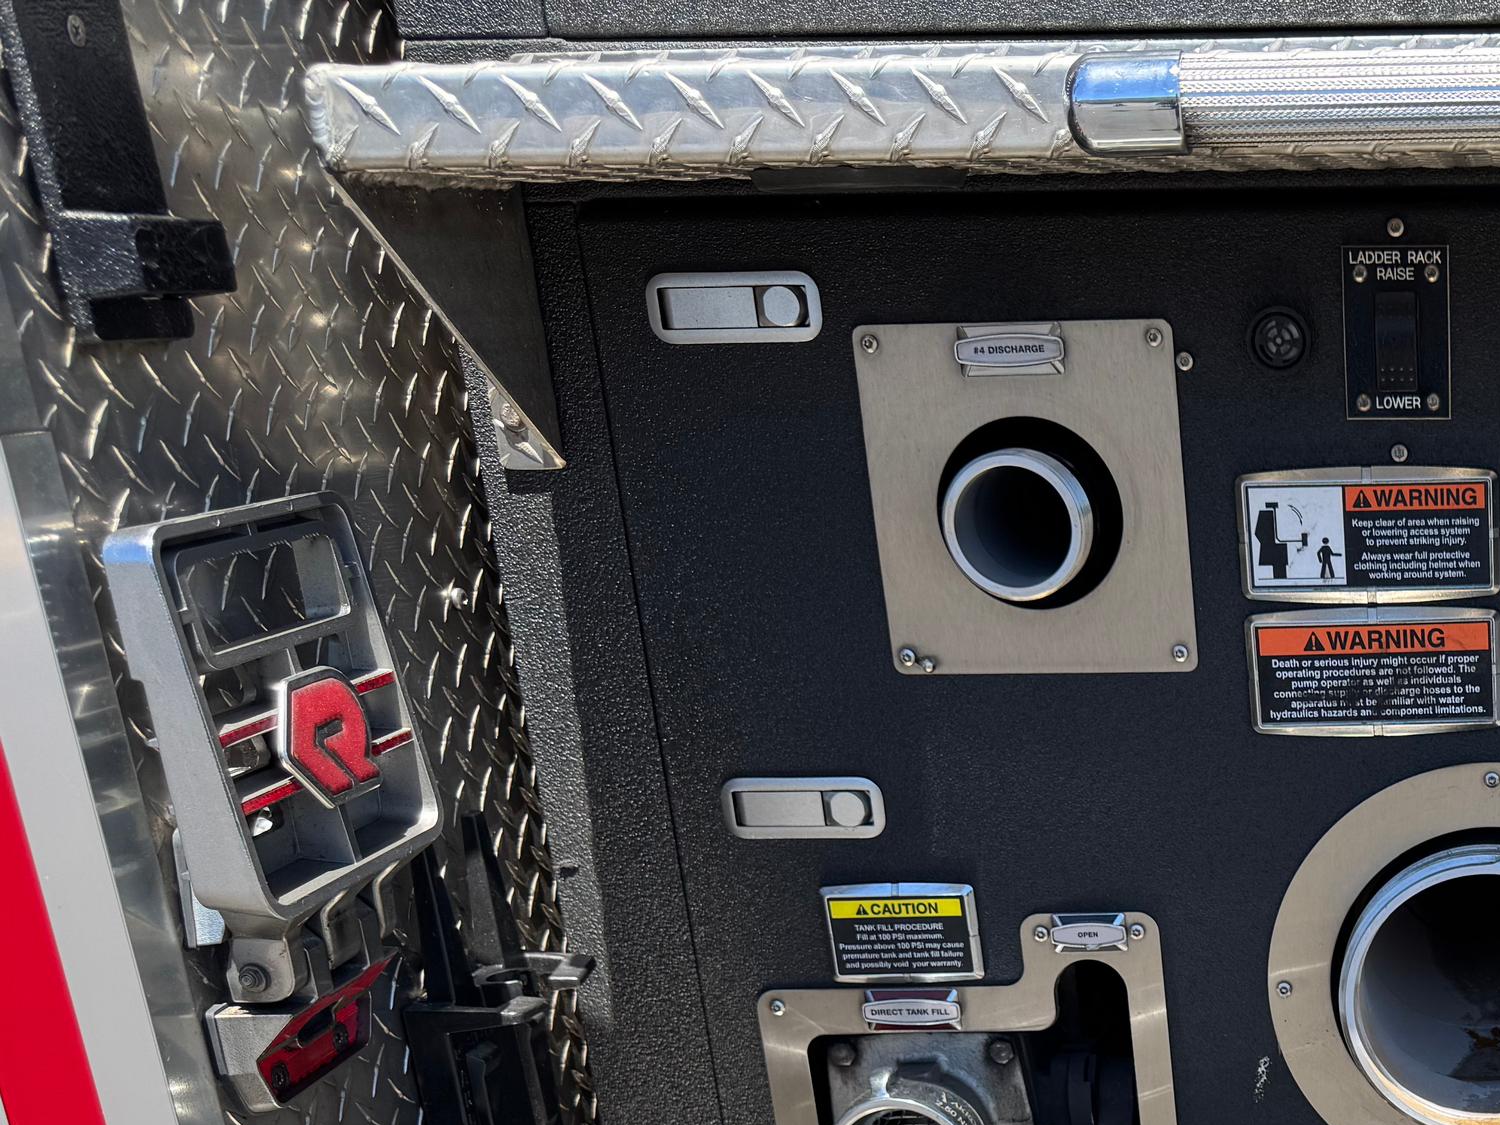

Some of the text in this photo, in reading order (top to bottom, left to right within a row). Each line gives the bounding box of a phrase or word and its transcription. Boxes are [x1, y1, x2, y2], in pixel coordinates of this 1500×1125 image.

[1349, 250, 1442, 264] LADDER RACK
[1377, 268, 1415, 280] RAISE
[974, 345, 1045, 354] #4 DISCHARGE
[1376, 396, 1421, 409] LOWER
[1373, 488, 1477, 507] WARNING
[1352, 517, 1480, 528] Keep clear of area when raising
[1373, 528, 1408, 537] lowering
[1441, 527, 1471, 536] system
[1366, 537, 1467, 547] to prevent striking injury.
[1361, 552, 1391, 561] Always
[1415, 551, 1428, 560] full
[1430, 551, 1470, 560] protective
[1354, 560, 1481, 571] clothing including helmet when
[1369, 570, 1467, 580] working around system.
[1326, 628, 1446, 651] WARNING
[1271, 654, 1480, 668] Death or serious injury might occur if proper
[1276, 664, 1476, 679] operating procedures are not followed. The
[1291, 680, 1319, 690] pump
[1411, 675, 1461, 685] individuals
[1423, 686, 1451, 694] hoses
[1465, 684, 1480, 693] the
[1291, 700, 1338, 709] apparatus
[1365, 697, 1378, 706] be
[1416, 695, 1436, 704] with
[1439, 695, 1464, 704] water
[1270, 709, 1319, 720] hydraulics
[1321, 708, 1358, 717] hazards
[1435, 704, 1487, 714] limitations.
[870, 902, 939, 916] CAUTION
[854, 924, 876, 932] TANK
[895, 923, 944, 931] PROCEDURE
[843, 953, 880, 961] premature
[861, 961, 892, 969] possibly
[912, 961, 929, 969] your
[871, 1008, 903, 1016] DIRECT
